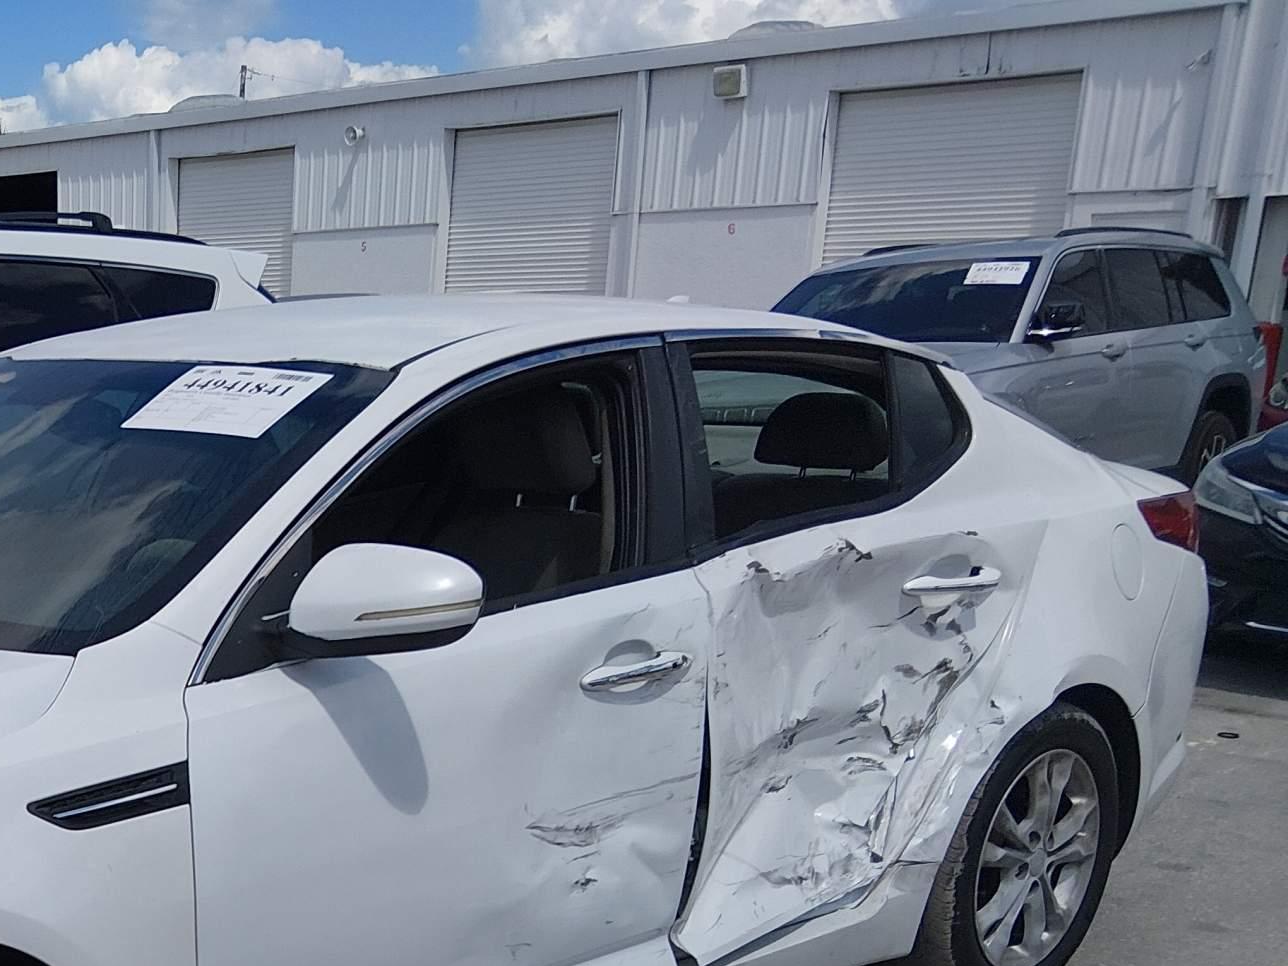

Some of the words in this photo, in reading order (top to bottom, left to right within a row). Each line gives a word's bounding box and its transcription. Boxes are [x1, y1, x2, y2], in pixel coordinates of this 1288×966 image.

[727, 223, 736, 236] 6
[361, 241, 367, 253] 5
[183, 377, 295, 397] 44941841
